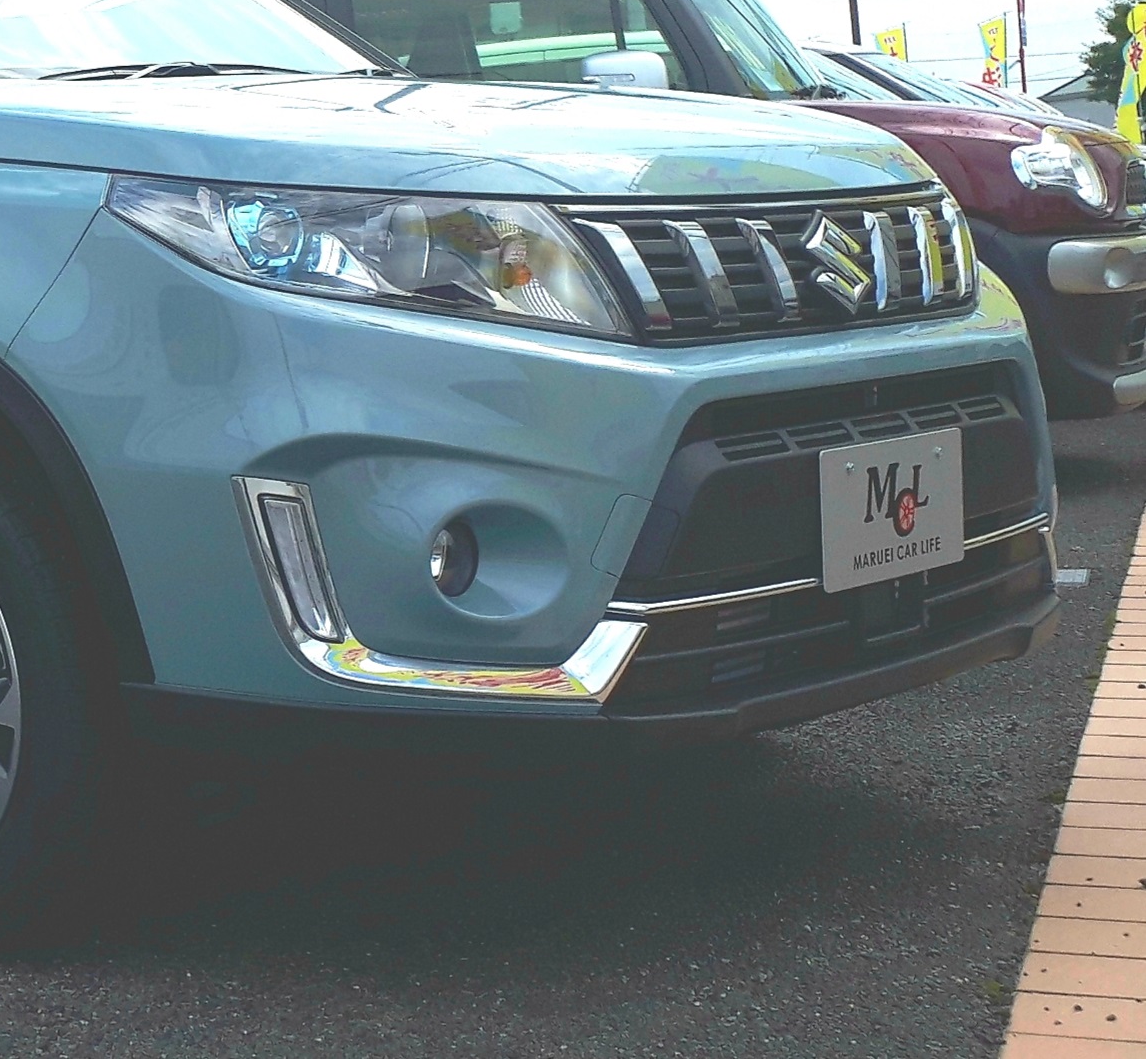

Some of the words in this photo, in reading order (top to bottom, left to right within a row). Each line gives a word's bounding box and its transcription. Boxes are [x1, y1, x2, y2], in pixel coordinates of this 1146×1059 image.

[853, 547, 894, 571] MARUEI
[897, 542, 918, 560] CAR
[920, 536, 941, 555] LIFE
